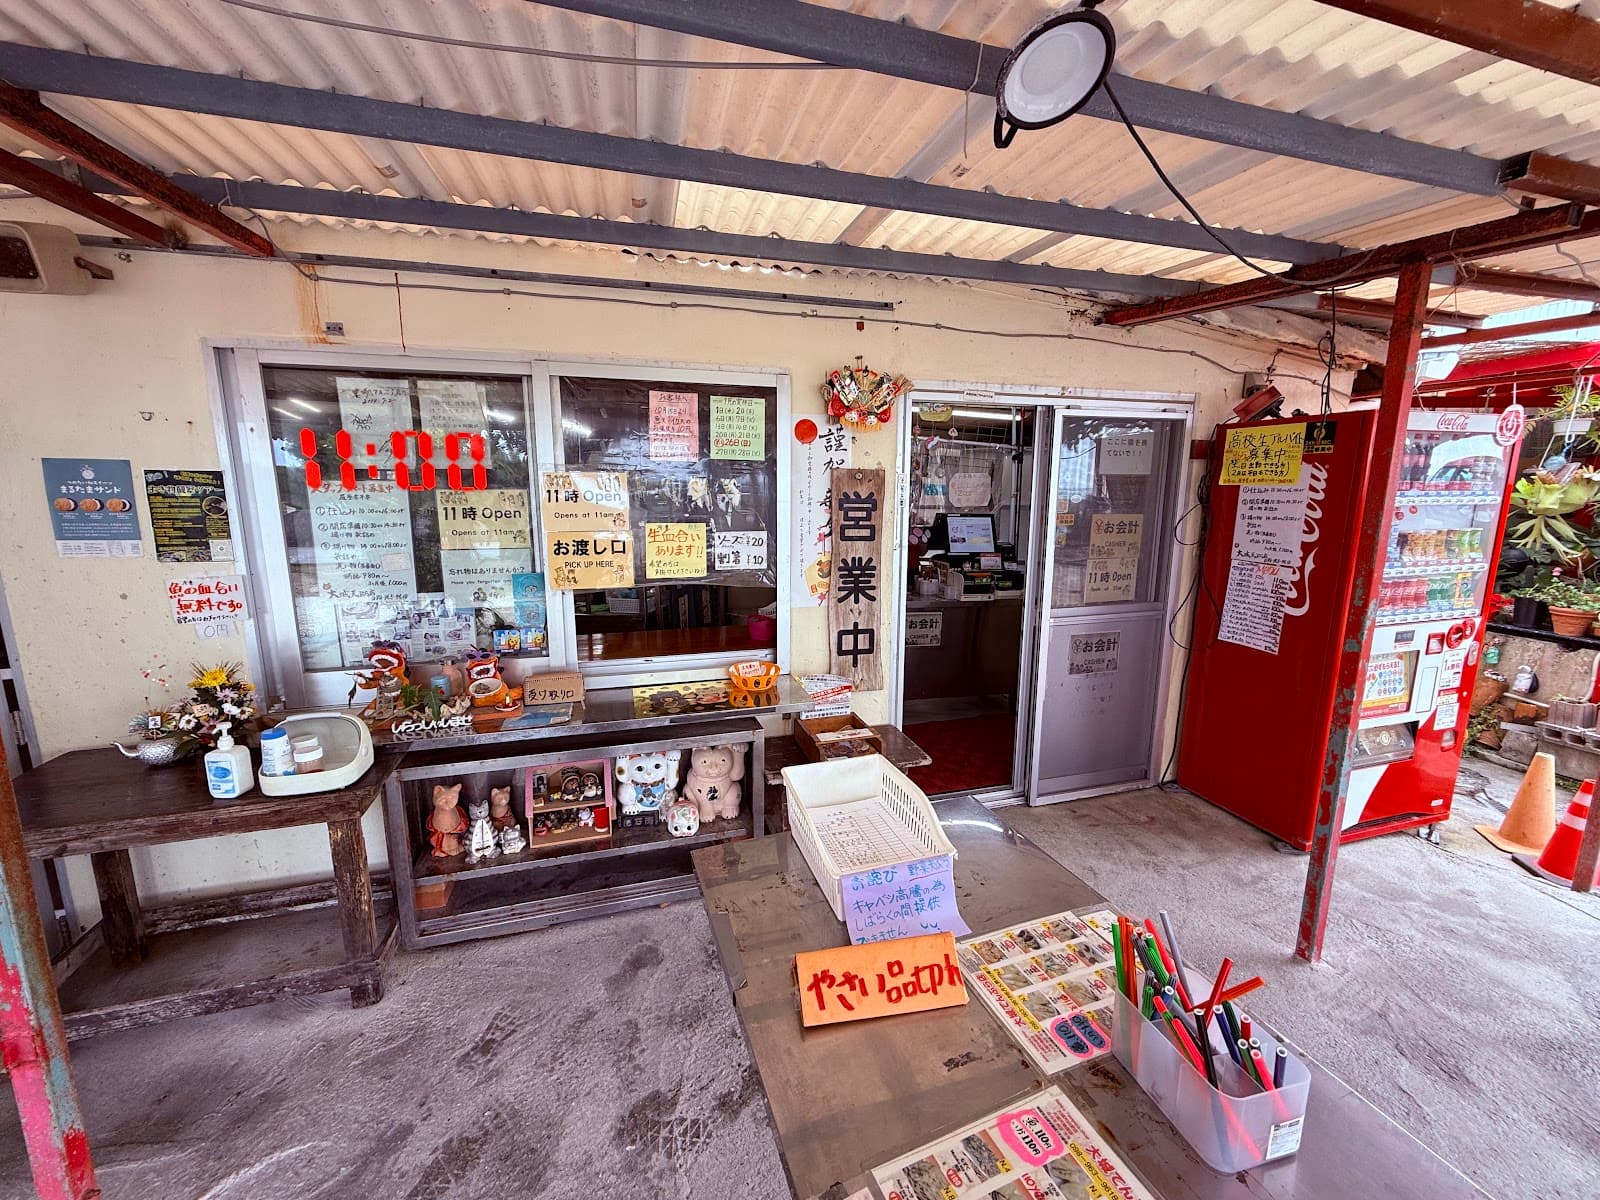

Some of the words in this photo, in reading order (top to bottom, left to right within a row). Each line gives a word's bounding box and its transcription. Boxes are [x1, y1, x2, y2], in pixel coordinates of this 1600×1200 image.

[583, 490, 622, 504] Open
[481, 507, 522, 522] Open
[451, 529, 477, 537] Opens
[1103, 520, 1140, 535] お会計
[647, 528, 701, 544] 生血合い
[553, 539, 626, 556] お渡し口
[564, 560, 581, 569] PICK
[584, 560, 594, 568] UP
[595, 560, 614, 568] HERE
[837, 490, 878, 669] 営業中
[1112, 571, 1132, 583] Open
[168, 581, 239, 599] 魚の血合い
[908, 617, 940, 629] お会計
[1082, 637, 1118, 653] お会計
[851, 866, 898, 891] お詫び
[853, 879, 946, 914] キャベツ高騰の為
[807, 953, 964, 1011] やさい品切れ
